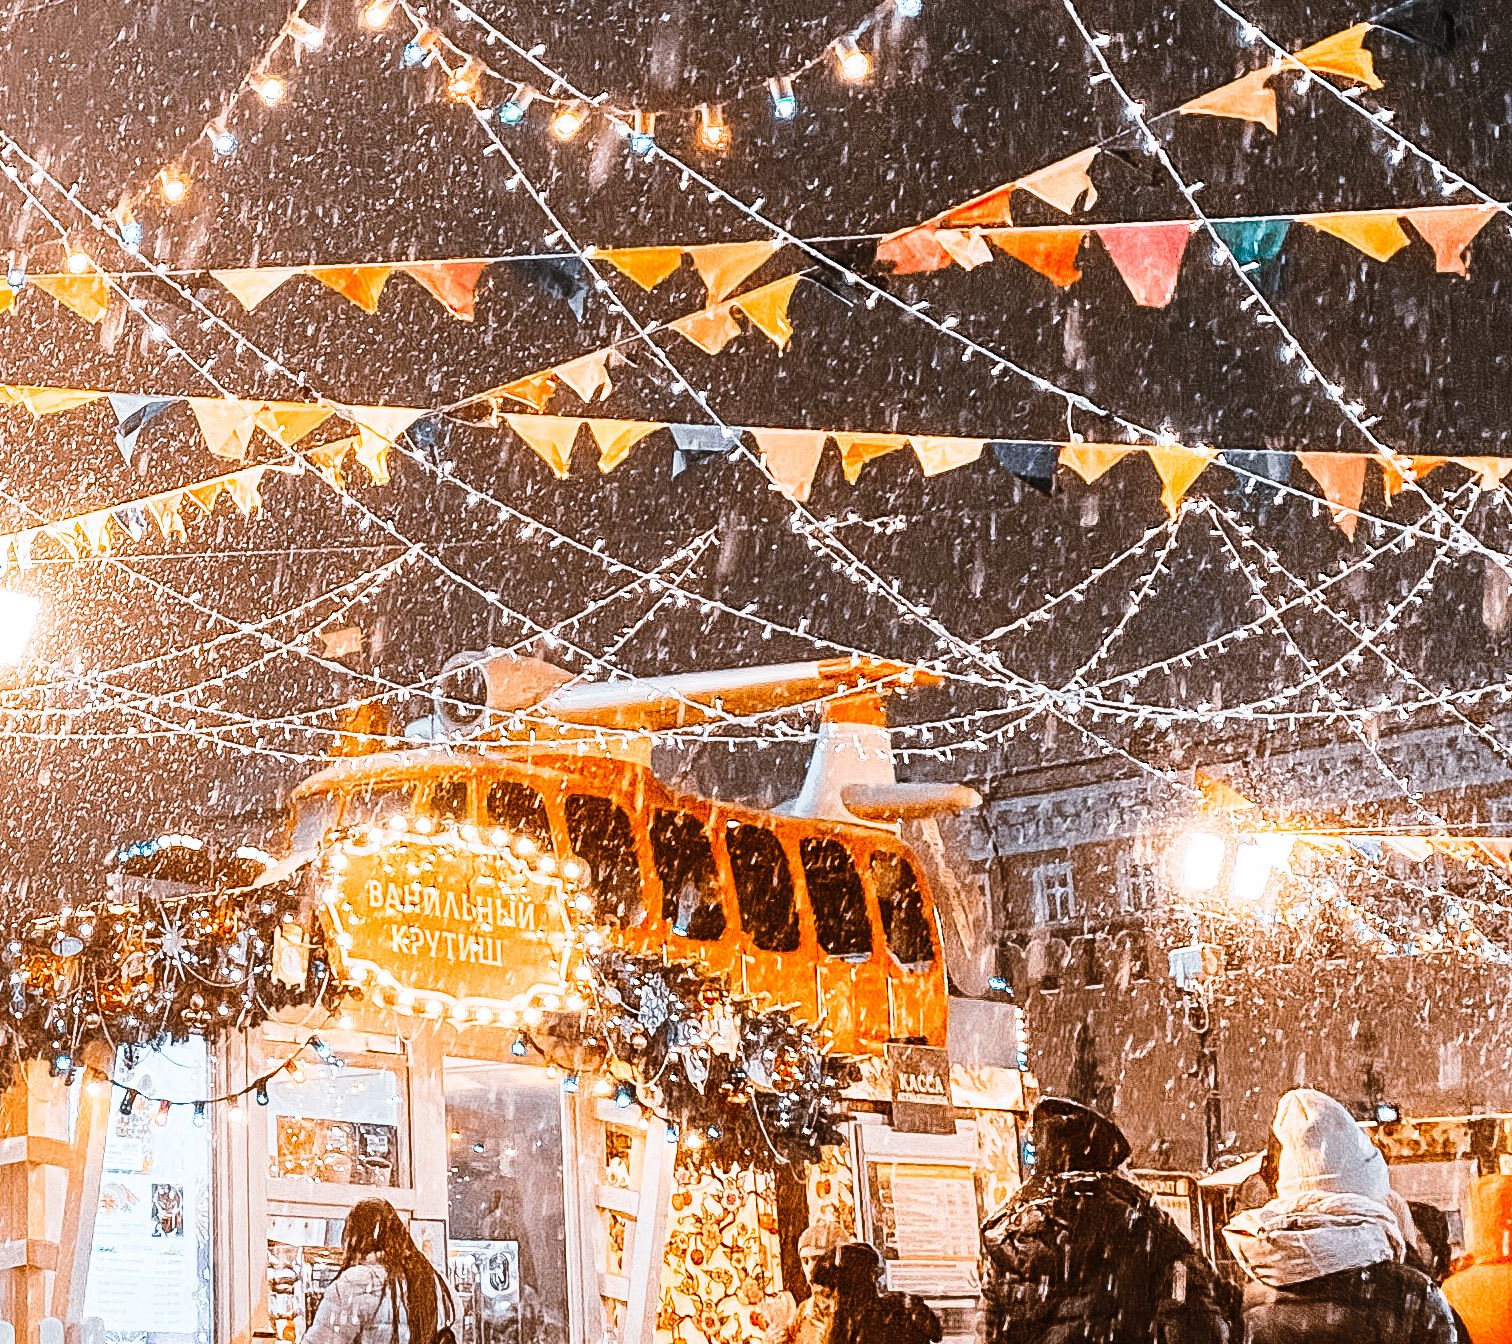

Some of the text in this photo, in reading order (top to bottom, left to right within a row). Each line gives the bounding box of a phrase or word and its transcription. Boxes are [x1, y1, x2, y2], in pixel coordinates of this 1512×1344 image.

[368, 880, 536, 931] ВАНИЛЬНЫЙ
[391, 924, 503, 967] КРУТИШ
[898, 1072, 945, 1094] КАССА
